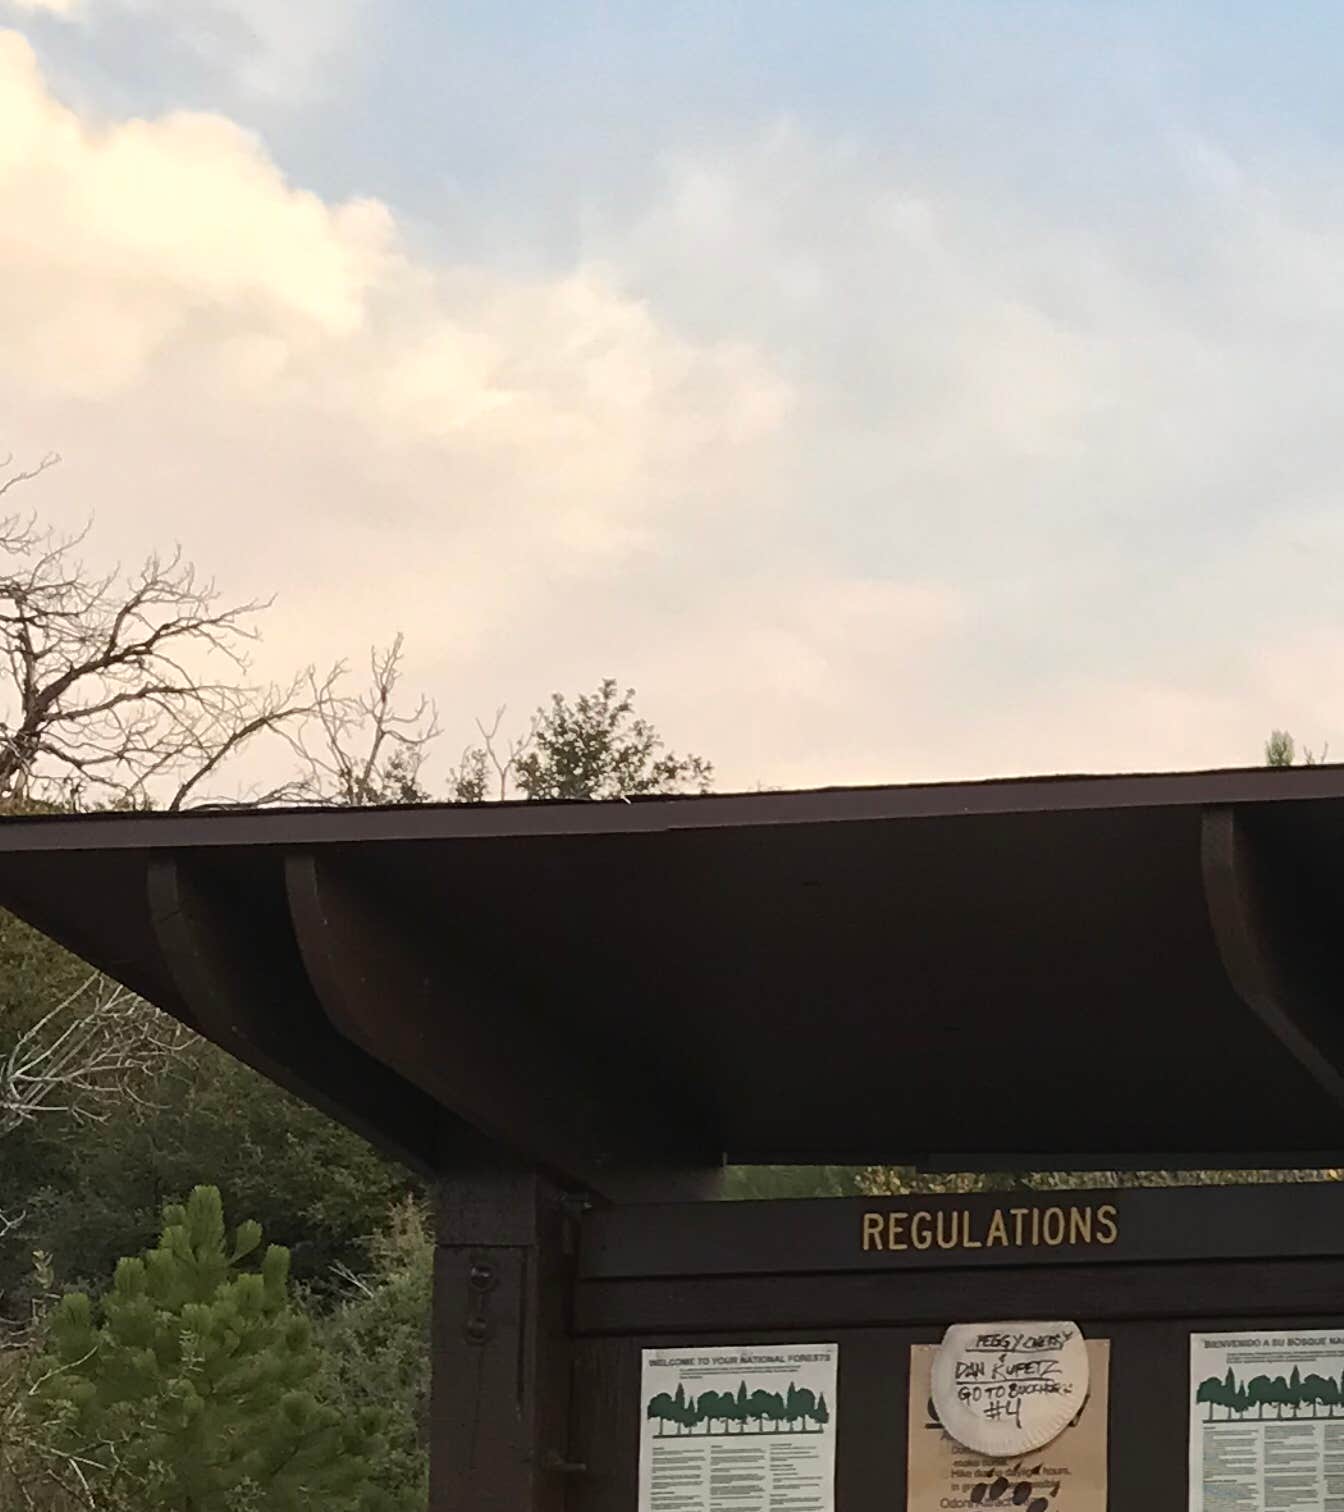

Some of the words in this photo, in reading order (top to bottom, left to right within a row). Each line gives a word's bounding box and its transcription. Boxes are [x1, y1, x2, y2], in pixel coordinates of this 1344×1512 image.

[862, 1204, 1119, 1251] REGULATIONS
[975, 1333, 1024, 1350] PEGGY
[1204, 1338, 1262, 1350] BIENVENIDO
[1263, 1337, 1271, 1347] A
[1272, 1337, 1286, 1347] SU
[1287, 1336, 1327, 1347] BOSQUE
[649, 1358, 696, 1367] WELCOME
[698, 1357, 710, 1366] TO
[712, 1356, 739, 1366] YOUR
[740, 1354, 785, 1365] NATIONAL
[787, 1353, 831, 1363] FORESTS
[954, 1361, 985, 1380] DAN
[957, 1386, 982, 1406] GO
[984, 1387, 1006, 1400] TO
[983, 1397, 1023, 1430] #4
